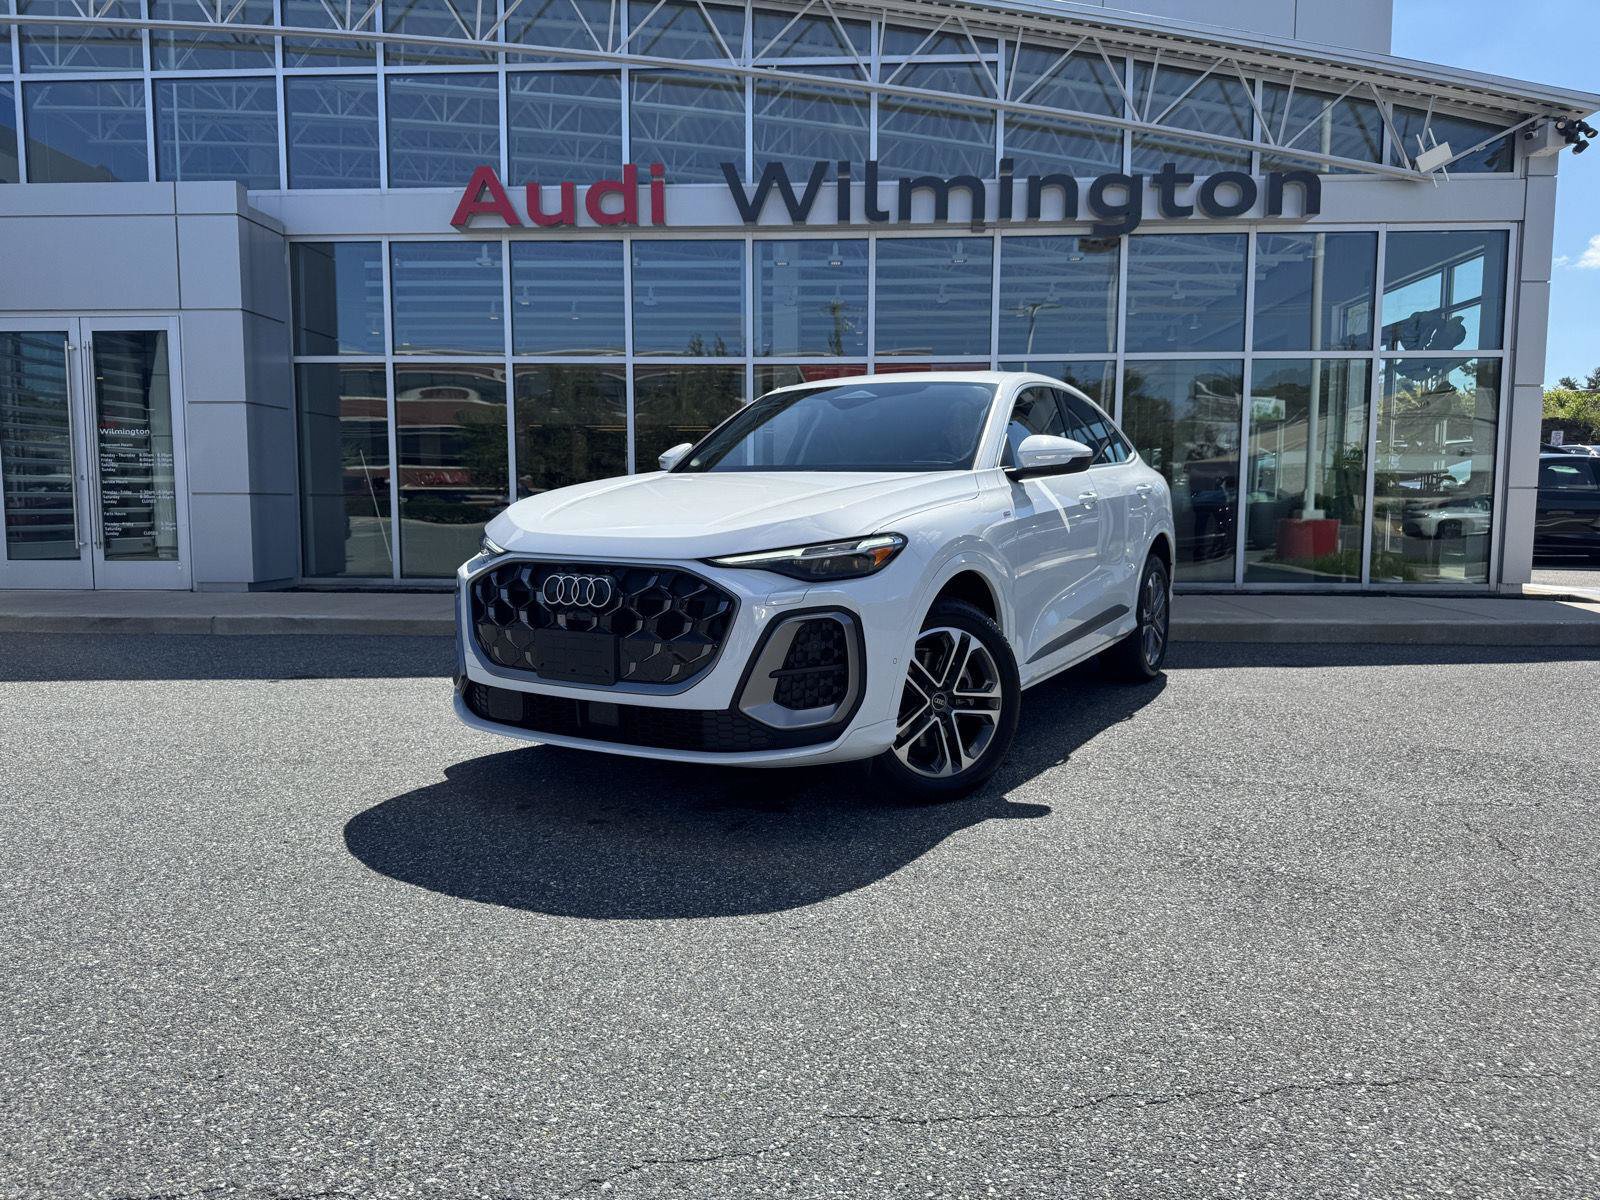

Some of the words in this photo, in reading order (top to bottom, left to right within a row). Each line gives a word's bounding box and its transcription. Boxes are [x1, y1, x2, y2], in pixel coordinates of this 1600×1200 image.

[450, 164, 666, 227] Audi
[720, 158, 1321, 237] Wilmington
[99, 428, 150, 436] Wilmington
